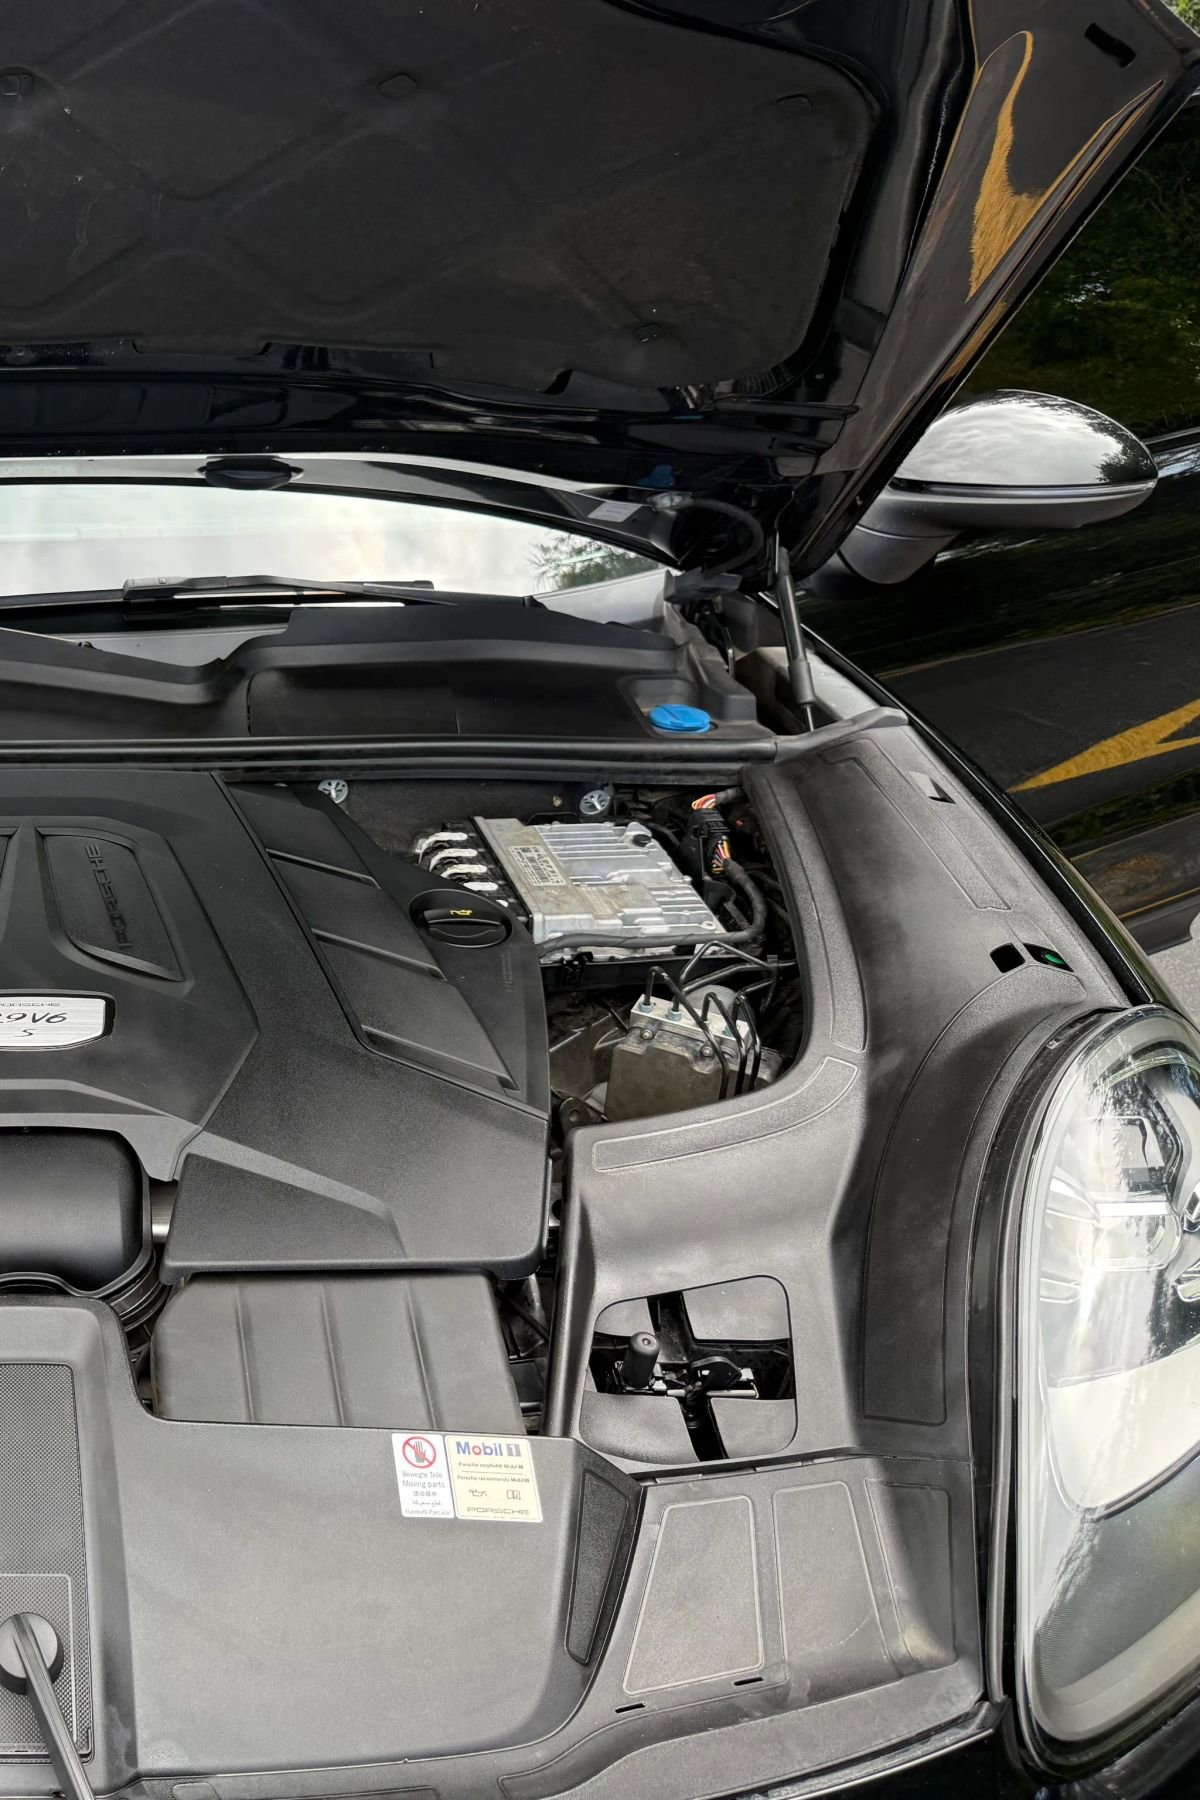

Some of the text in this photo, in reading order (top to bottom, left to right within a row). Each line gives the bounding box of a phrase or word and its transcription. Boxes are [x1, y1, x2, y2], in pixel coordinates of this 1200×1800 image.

[85, 844, 134, 947] PORSCHE
[13, 1028, 37, 1039] S
[456, 1441, 519, 1457] Mobil 1
[402, 1479, 446, 1489] Moving parts
[467, 1506, 529, 1515] PORSCHE
